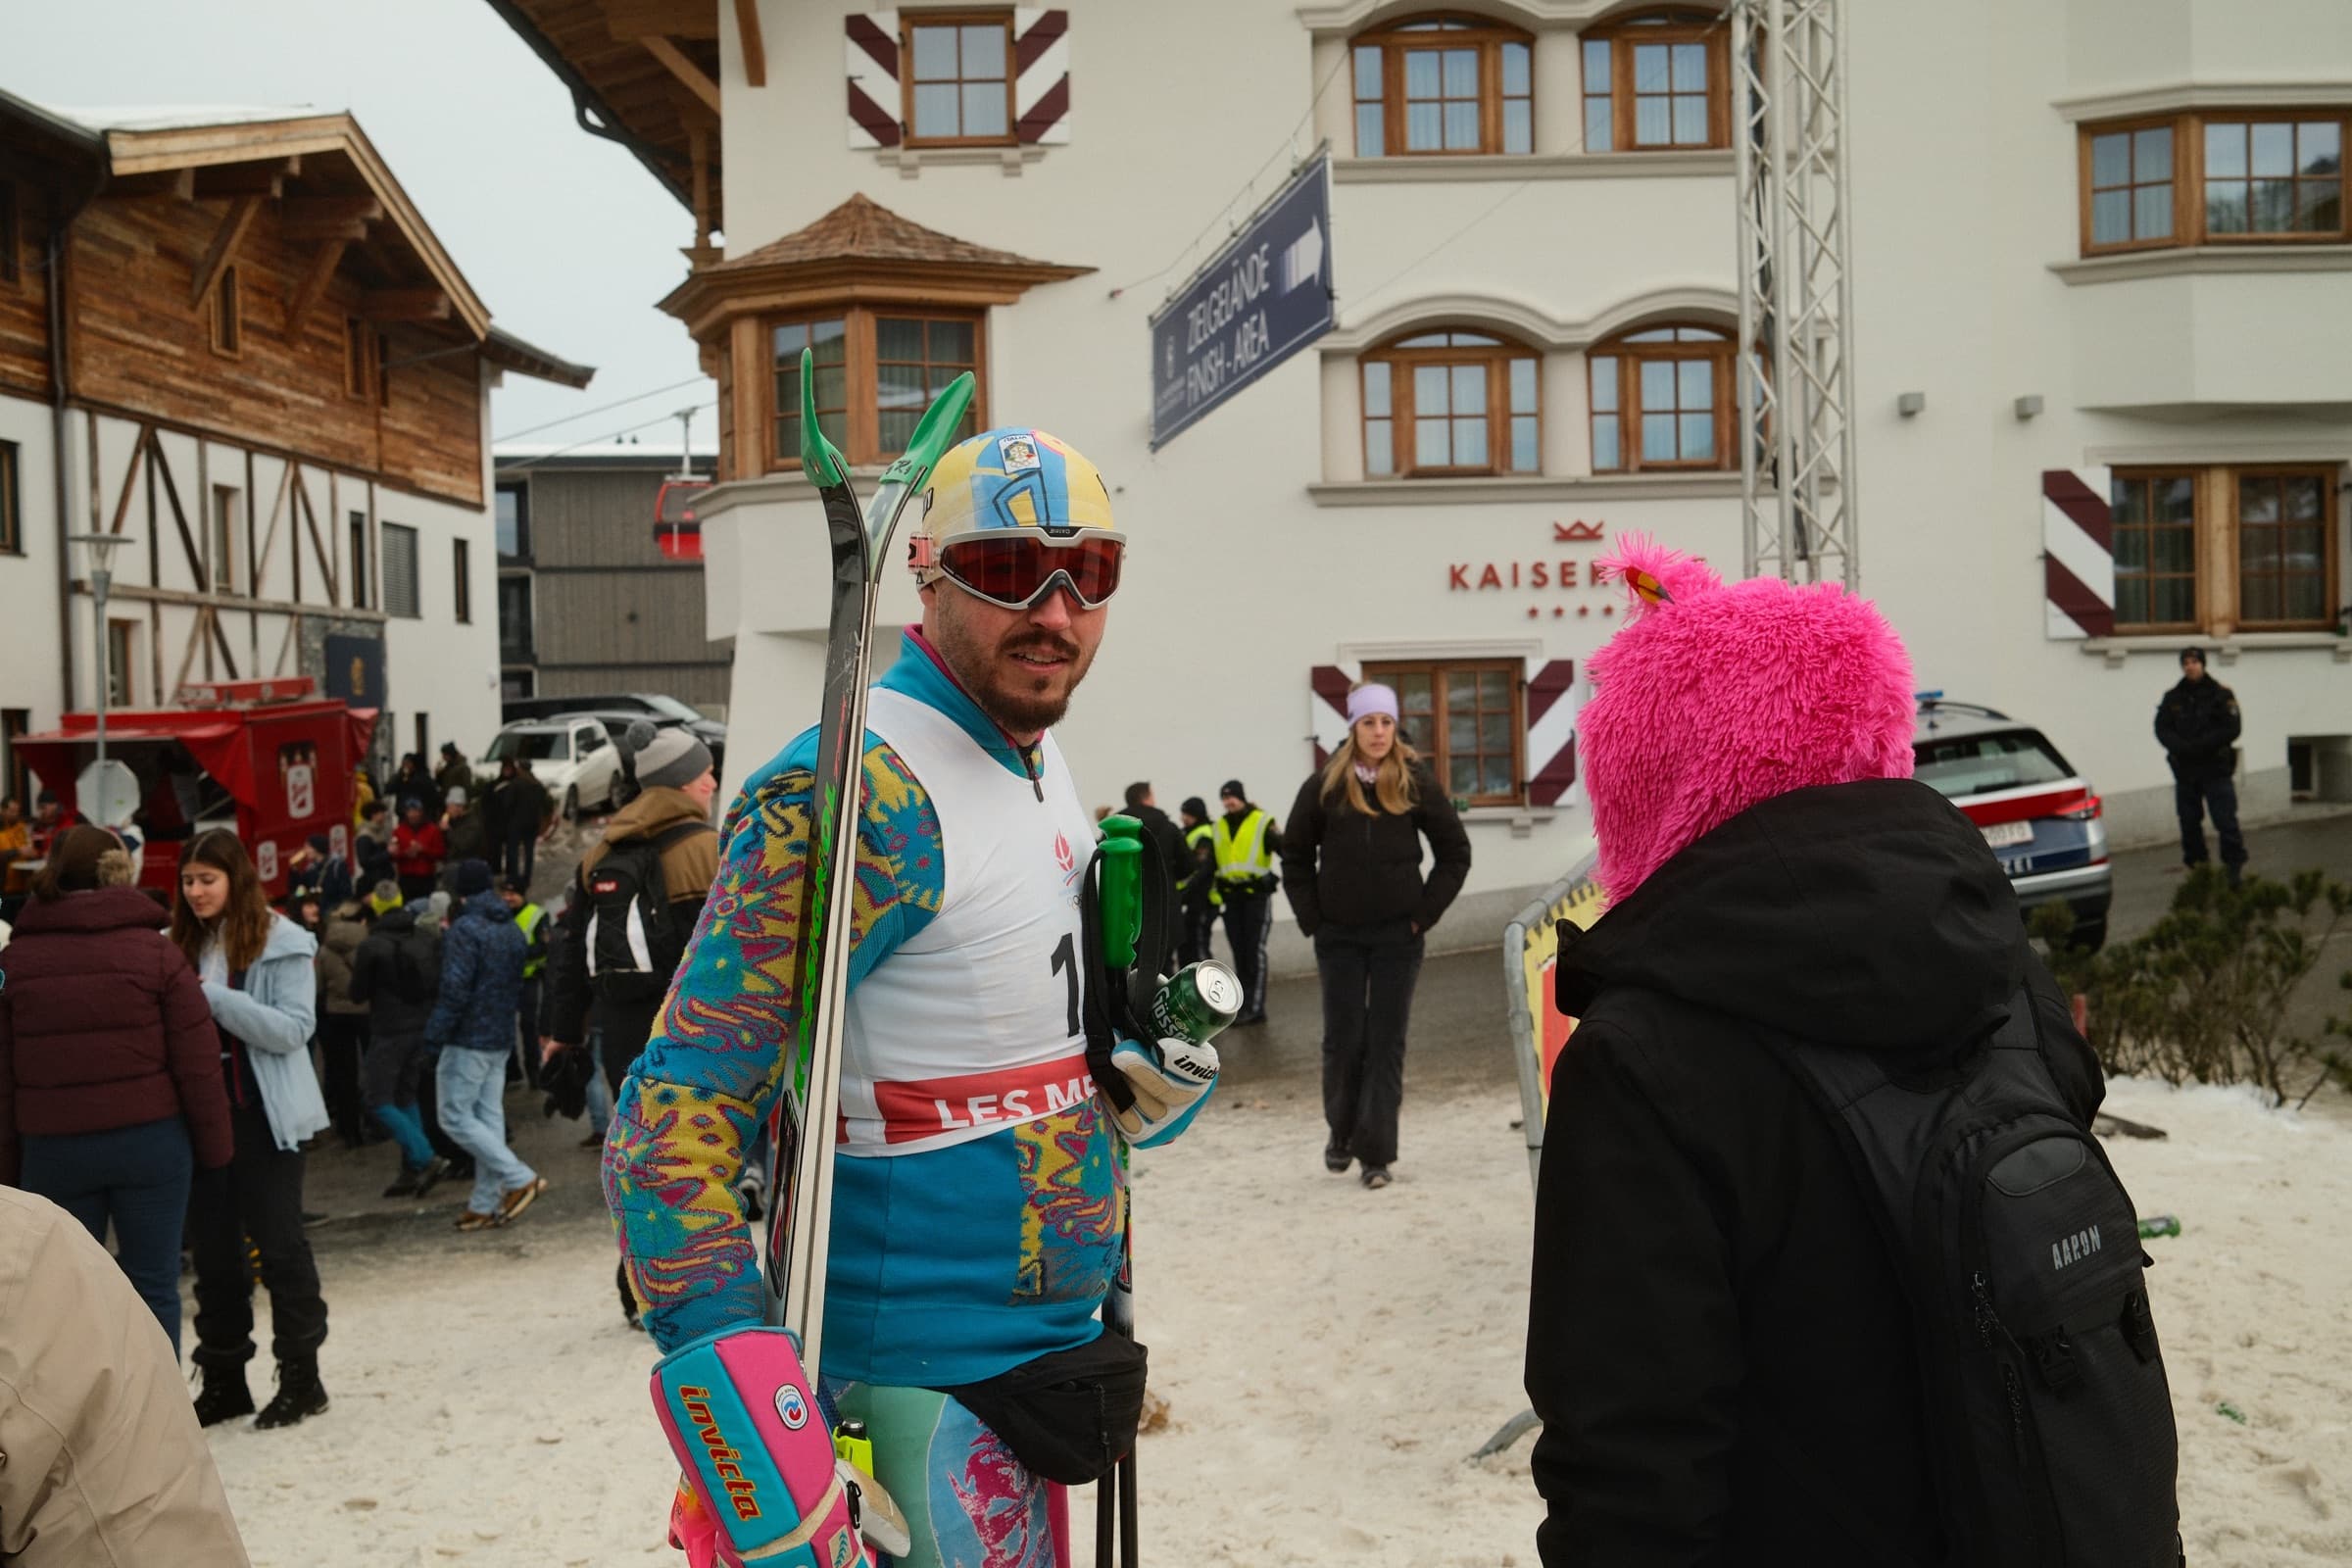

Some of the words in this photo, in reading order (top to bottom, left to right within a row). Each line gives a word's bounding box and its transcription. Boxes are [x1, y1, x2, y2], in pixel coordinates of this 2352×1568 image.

[1187, 243, 1270, 355] ZIELGELÄNDE
[1187, 342, 1225, 408] FINISH
[1233, 310, 1269, 373] AREA
[1448, 561, 1625, 591] KAISER
[794, 780, 838, 1107] ROSSIGNOL
[934, 1089, 1032, 1129] LES
[1044, 1074, 1099, 1110] ME
[678, 1385, 762, 1521] invicta
